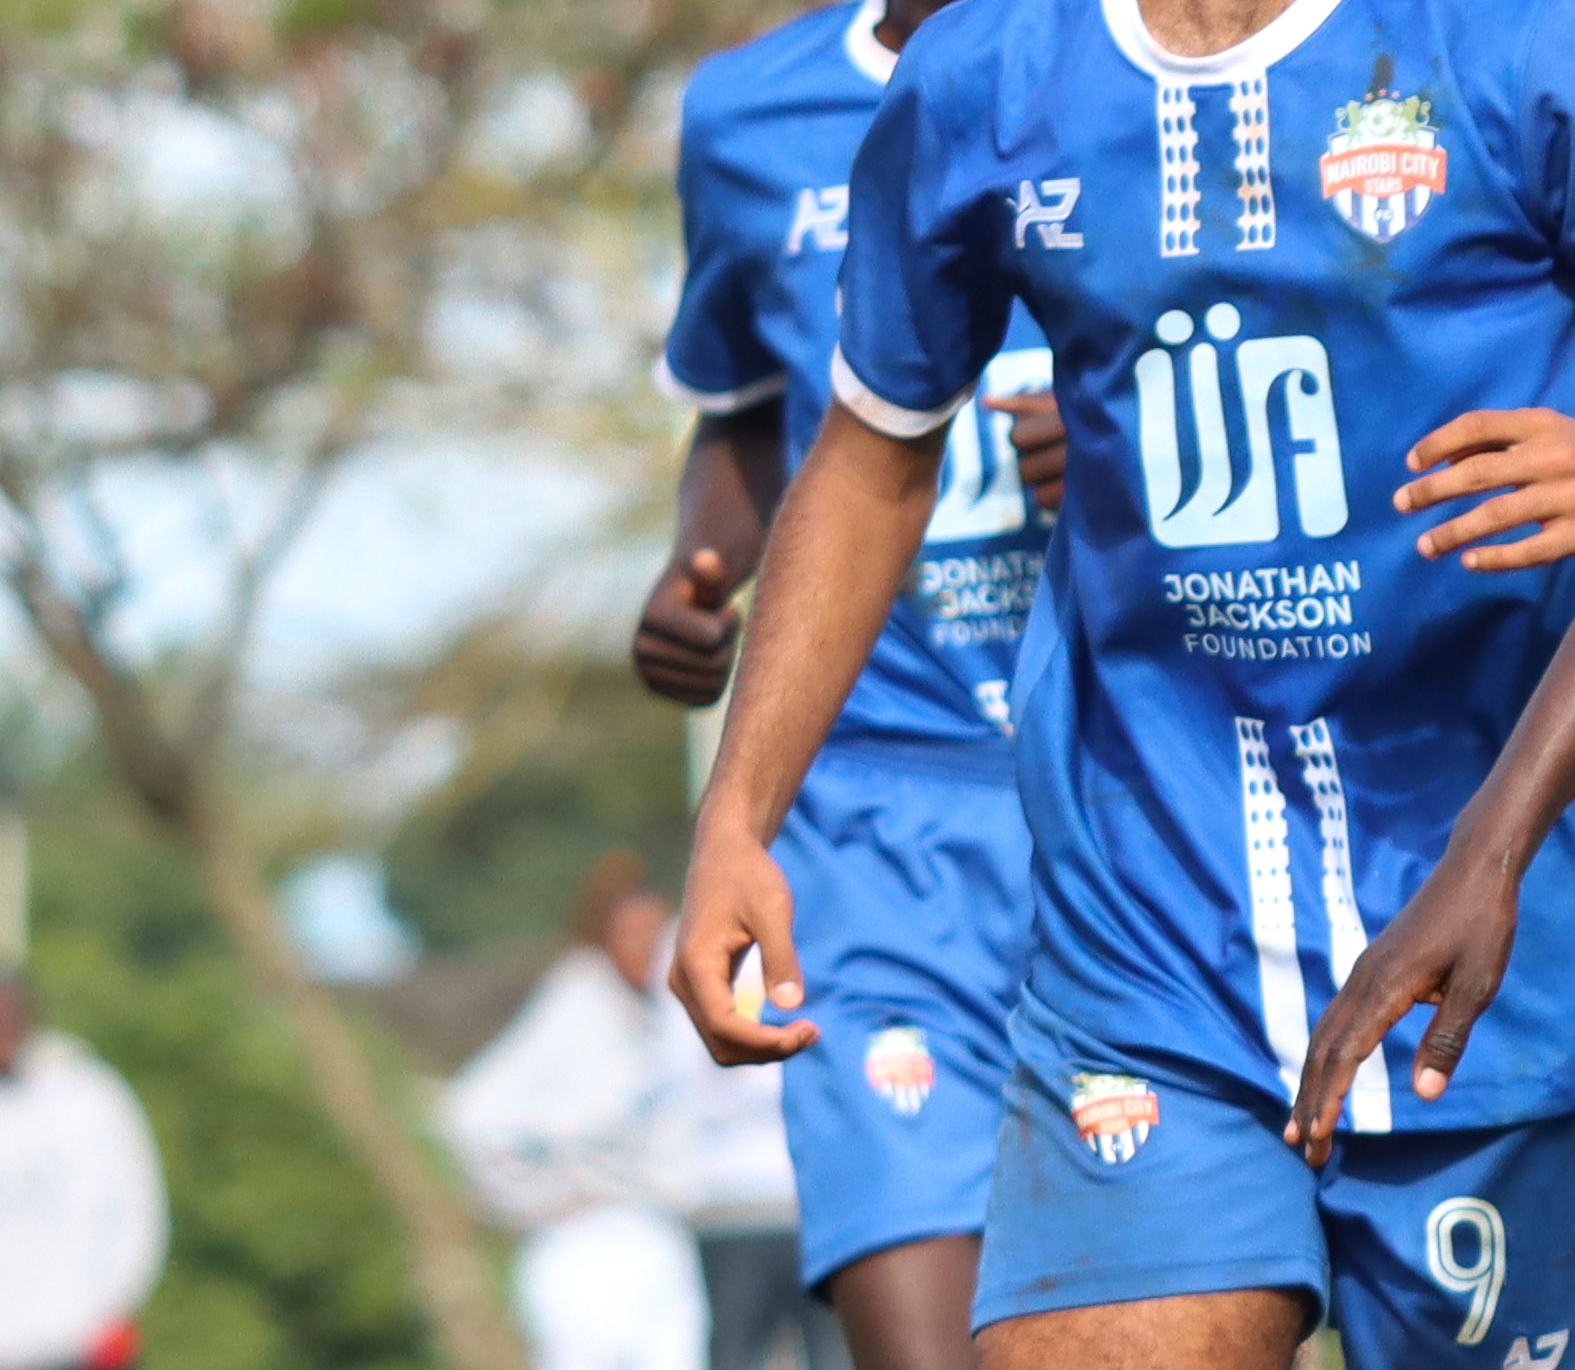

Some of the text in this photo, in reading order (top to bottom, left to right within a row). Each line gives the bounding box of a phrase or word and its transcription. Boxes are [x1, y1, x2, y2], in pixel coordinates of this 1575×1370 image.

[1327, 151, 1440, 185] NAIROBI CITY
[1163, 559, 1362, 603] JONATHAN
[1186, 594, 1352, 630] JACKSON
[1185, 631, 1372, 660] FOUNDATION
[1426, 1196, 1507, 1346] 9
